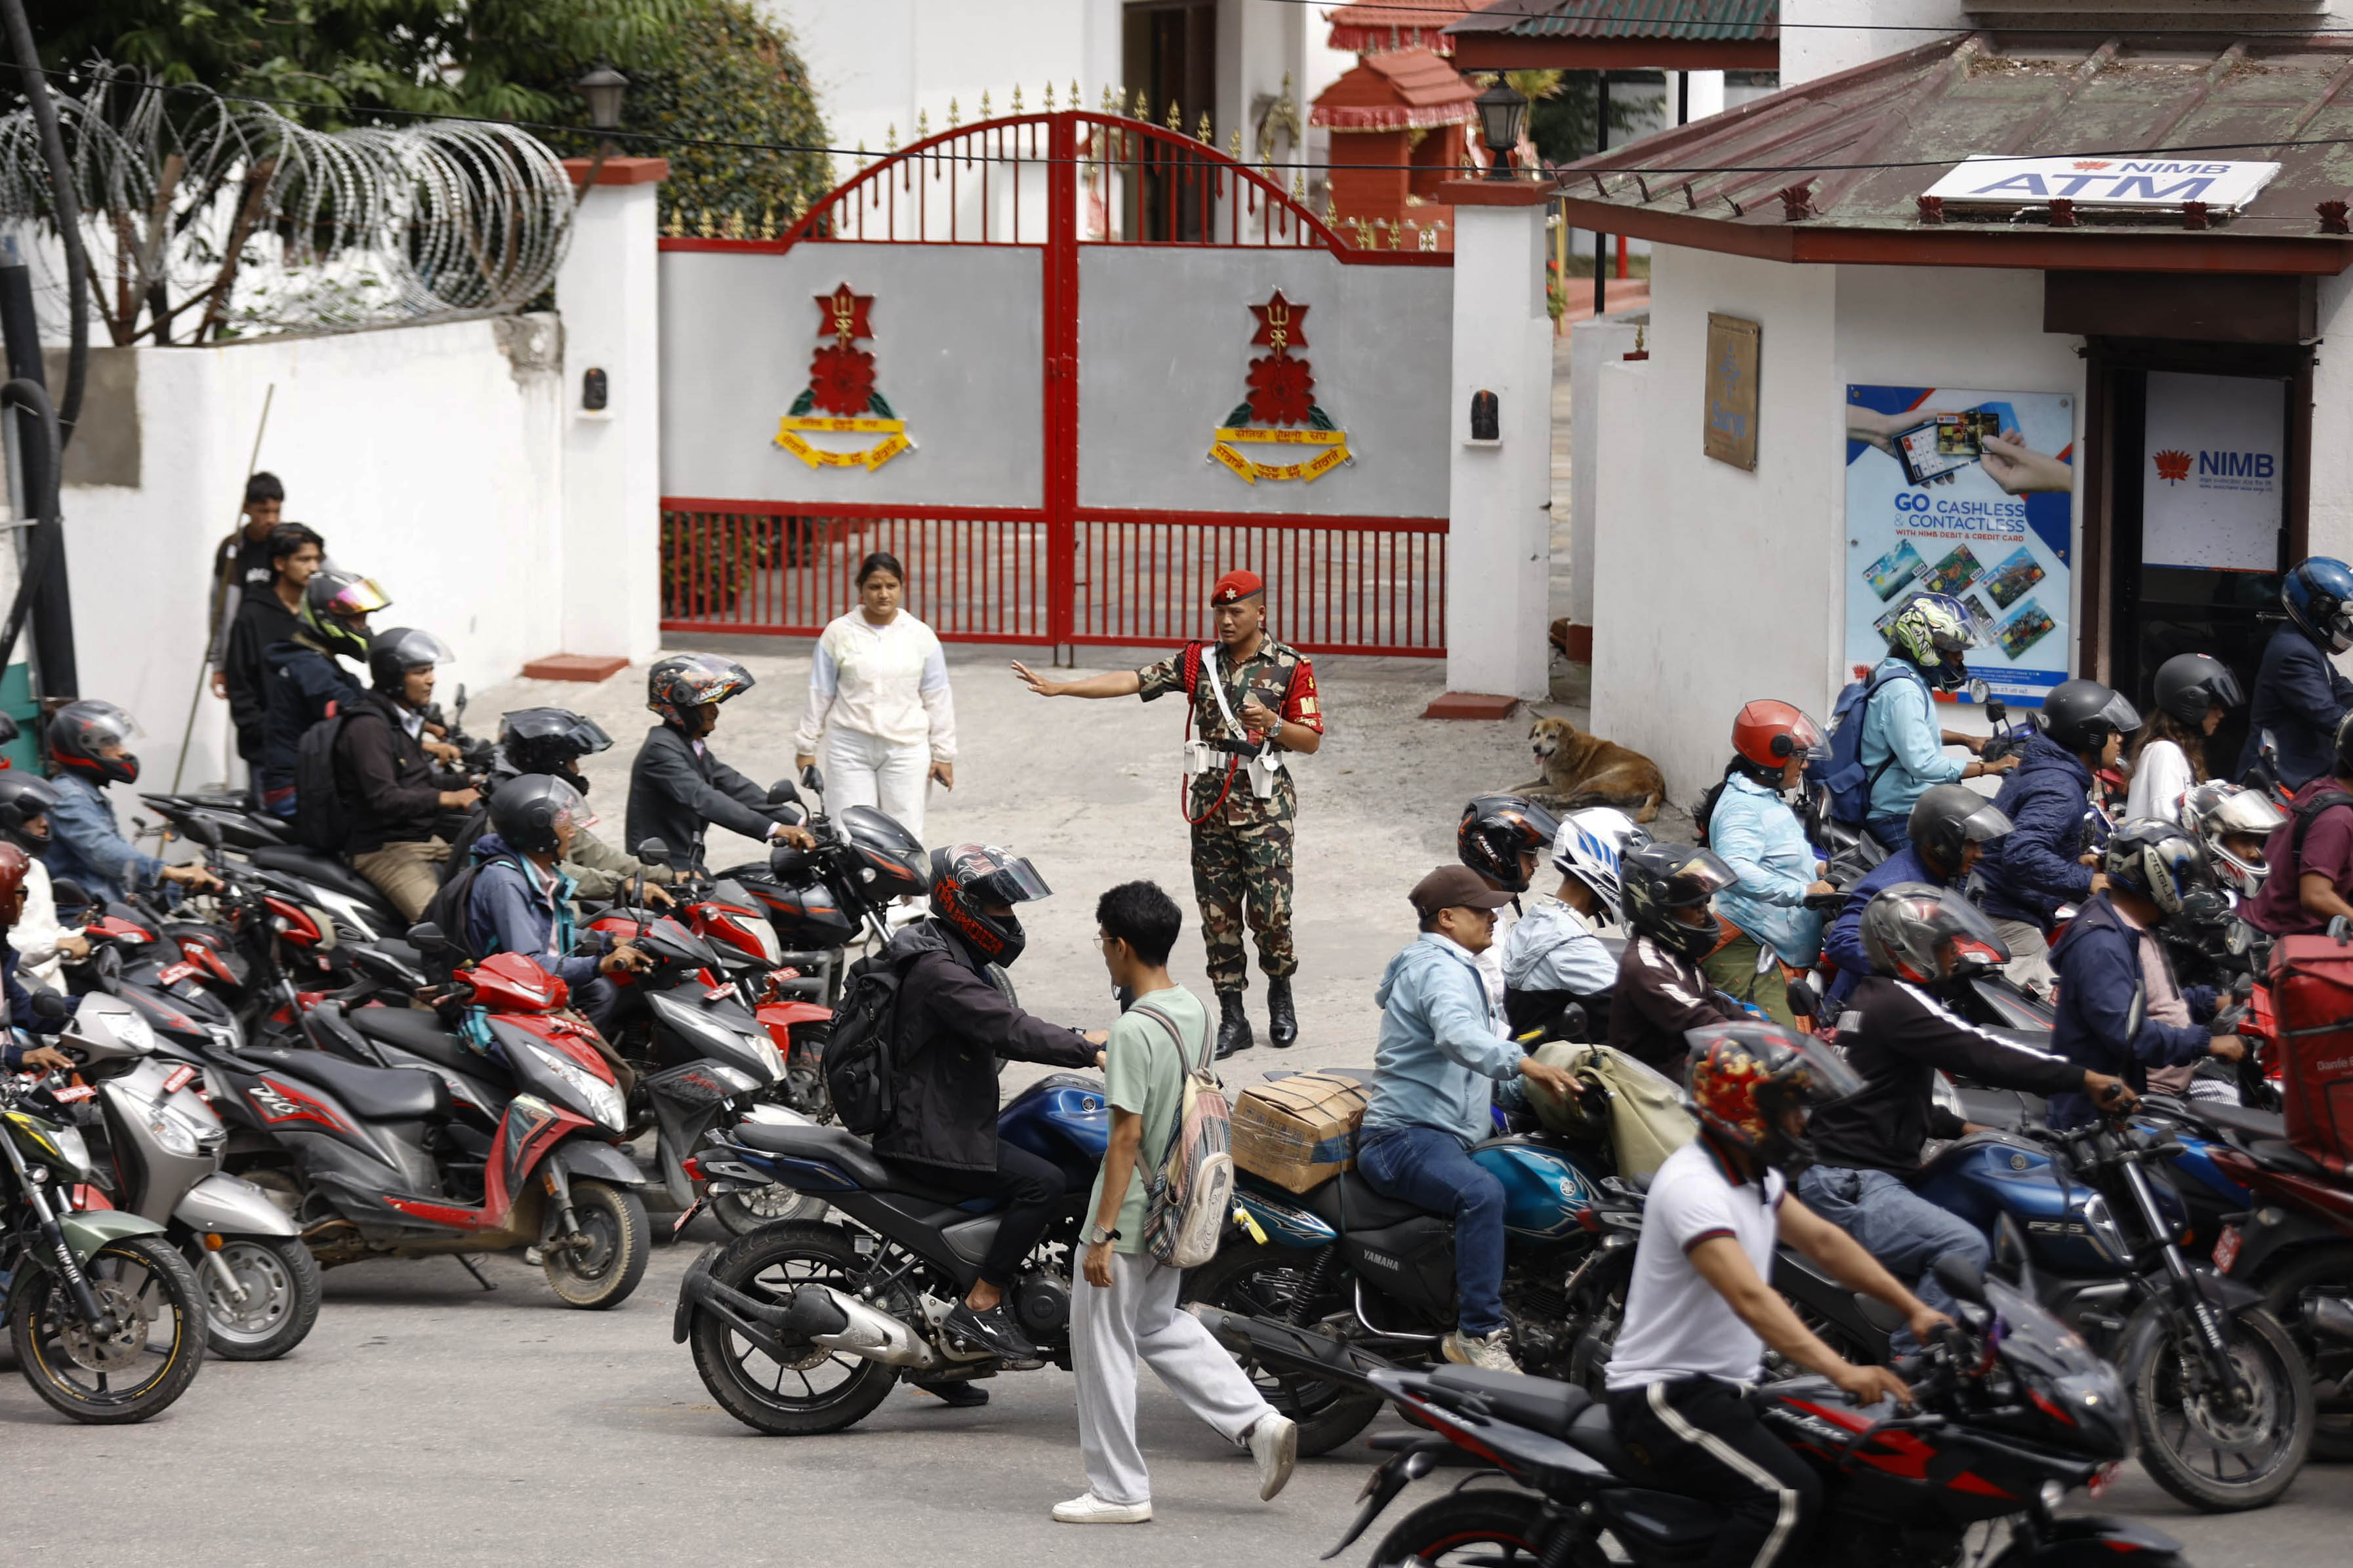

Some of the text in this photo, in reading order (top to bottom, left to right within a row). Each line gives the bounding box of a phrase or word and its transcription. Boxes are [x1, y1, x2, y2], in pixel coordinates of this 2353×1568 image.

[2119, 162, 2231, 174] NIMB
[1968, 172, 2217, 199] ATM
[2199, 451, 2274, 477] NIMB
[1894, 493, 2024, 517] GO CASHLESS
[1894, 513, 2025, 533] & CONTACTLESS
[1913, 564, 1925, 574] VISA
[1971, 569, 1982, 579] VISA
[2317, 1058, 2348, 1070] Danfe
[1364, 1249, 1399, 1272] YAMAHA
[2194, 1302, 2222, 1348] YAMAHA
